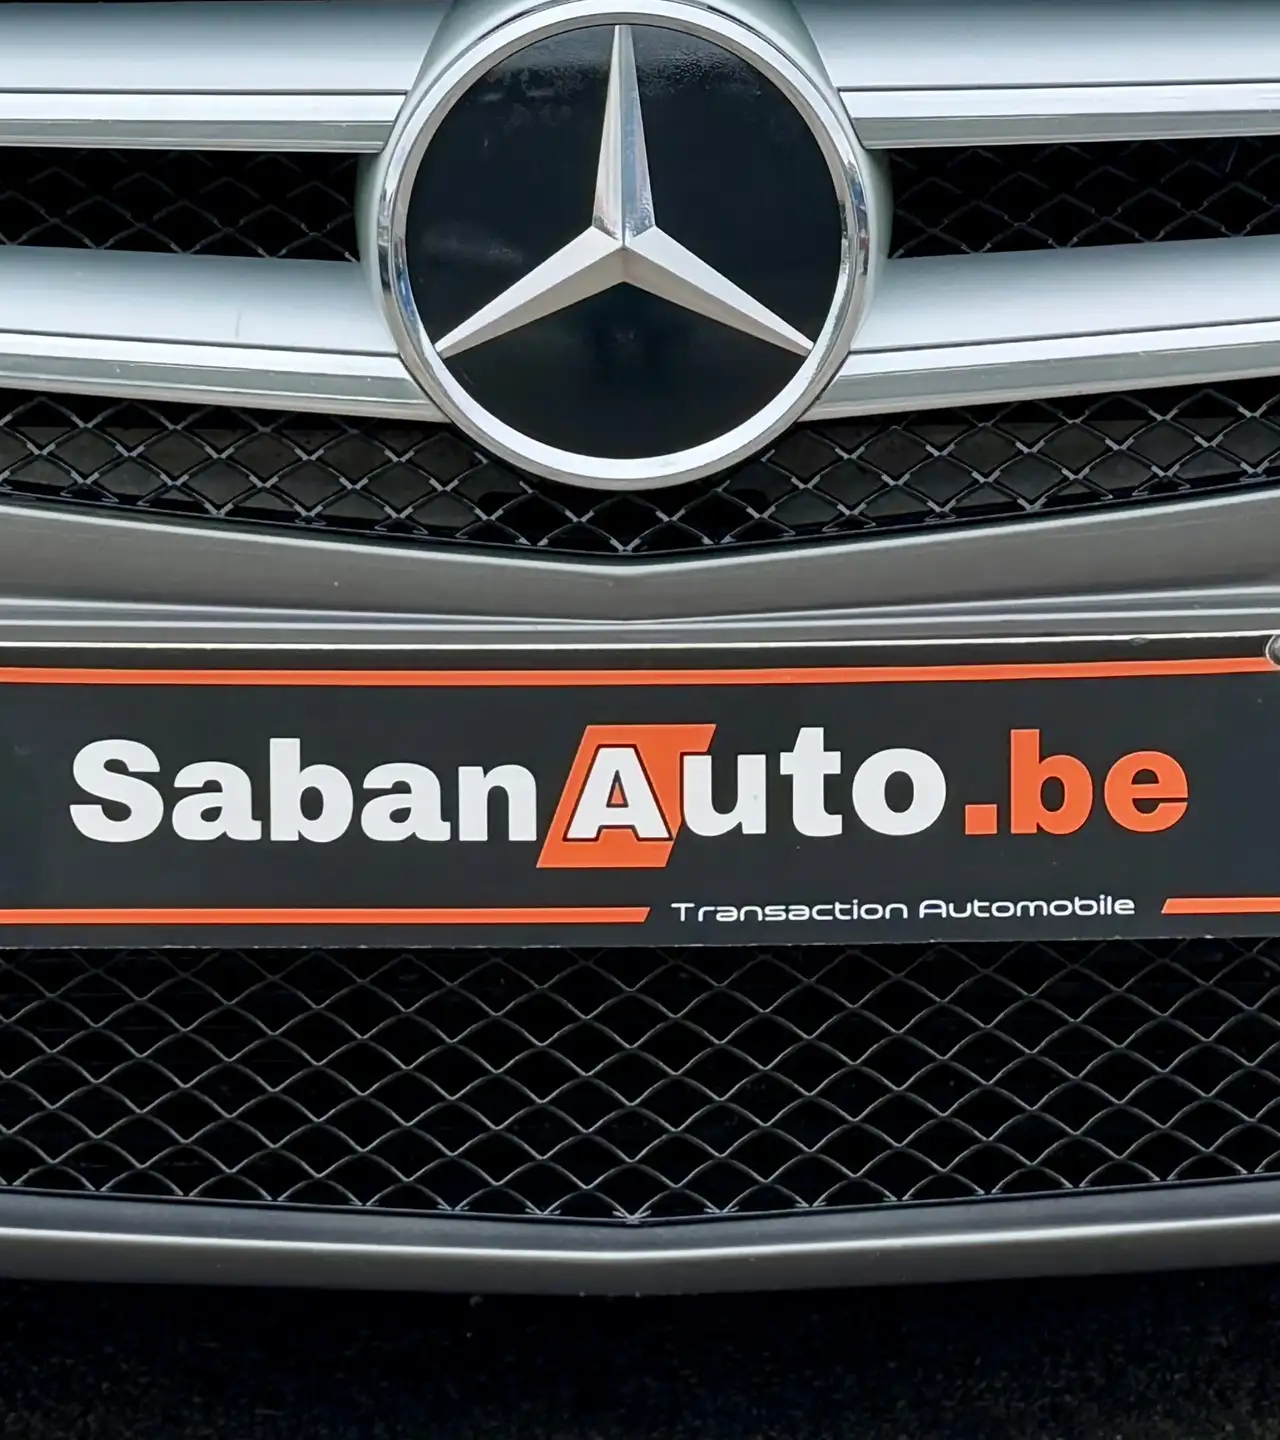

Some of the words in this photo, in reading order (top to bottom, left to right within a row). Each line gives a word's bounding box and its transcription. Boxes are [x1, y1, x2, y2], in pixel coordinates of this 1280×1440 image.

[69, 726, 1189, 844] SabanAuto.be
[670, 898, 909, 923] Transaction
[918, 894, 1136, 920] Automobile
